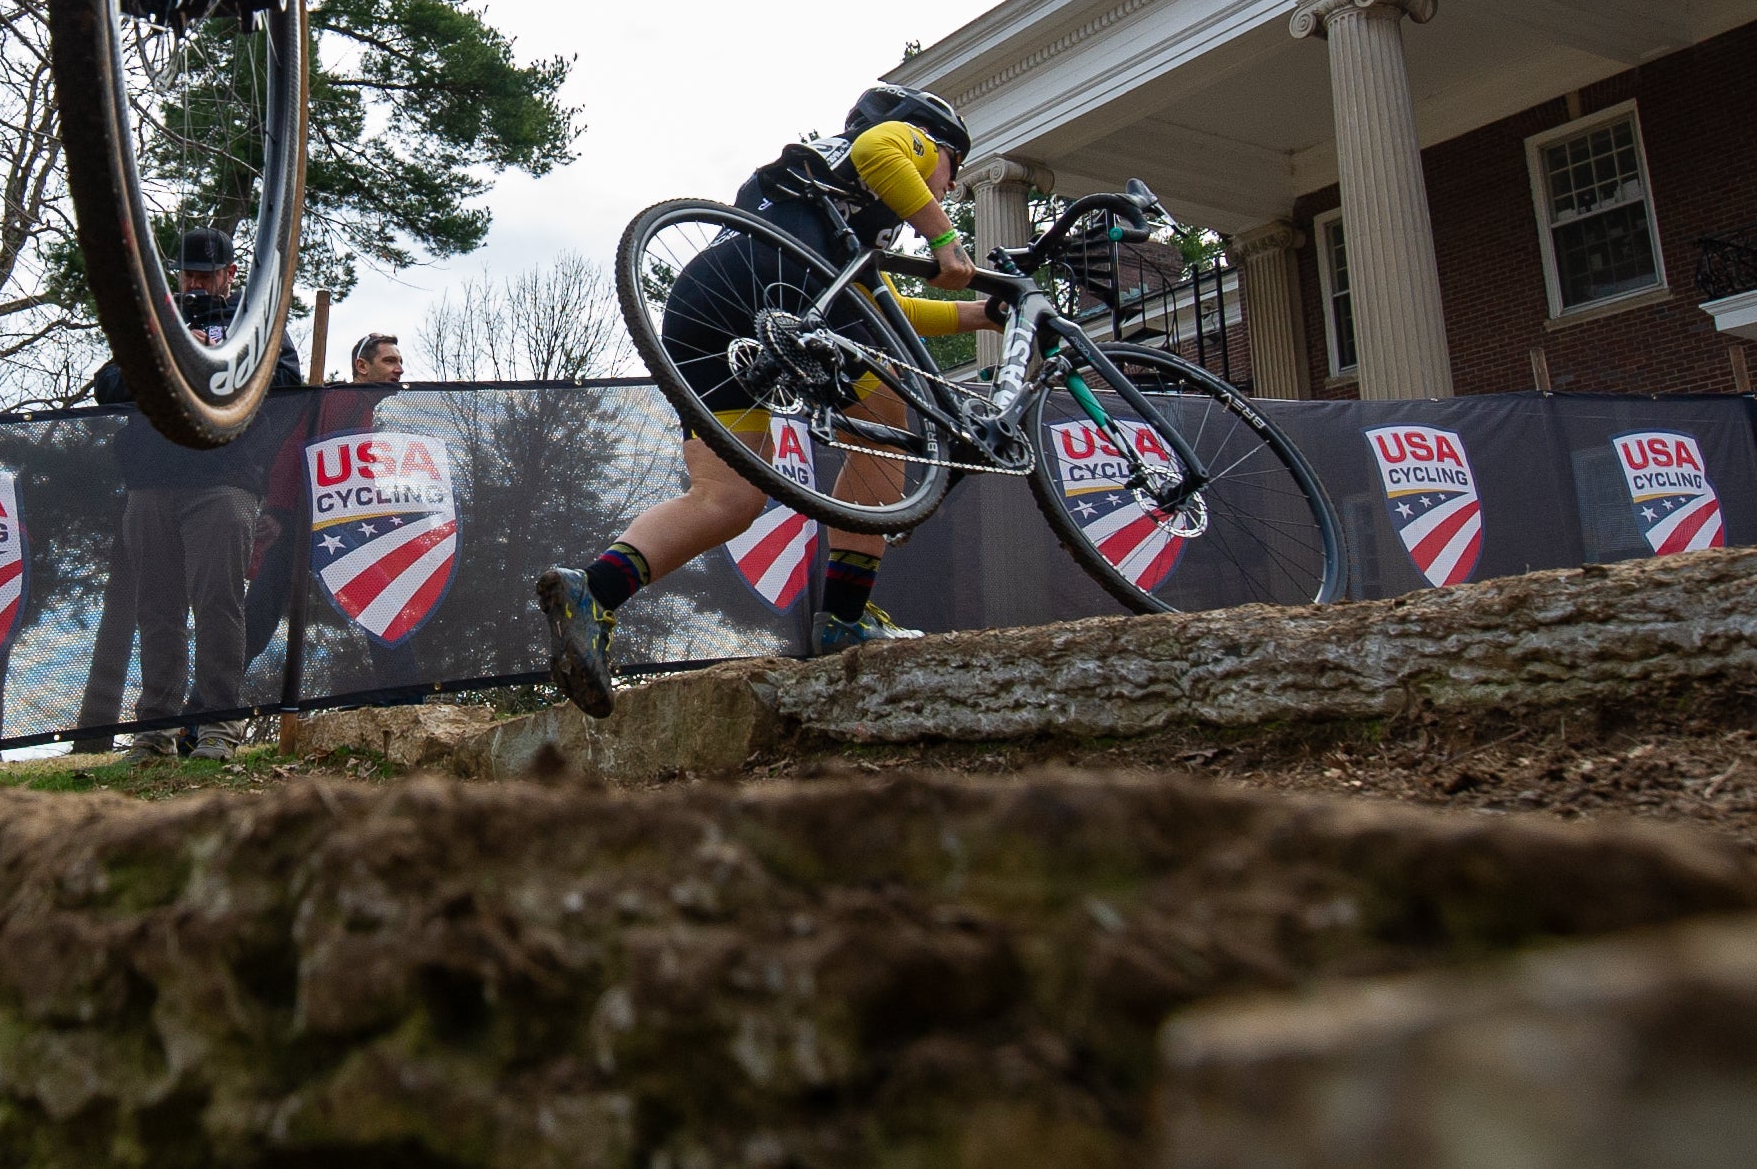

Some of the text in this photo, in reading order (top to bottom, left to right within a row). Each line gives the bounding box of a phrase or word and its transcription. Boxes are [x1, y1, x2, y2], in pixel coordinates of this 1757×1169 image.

[316, 441, 443, 487] USA
[1375, 432, 1464, 467] USA
[1621, 438, 1702, 471] USA
[1388, 466, 1469, 485] CYCLING
[1633, 472, 1702, 490] CYCLING
[316, 484, 444, 513] CYCLING
